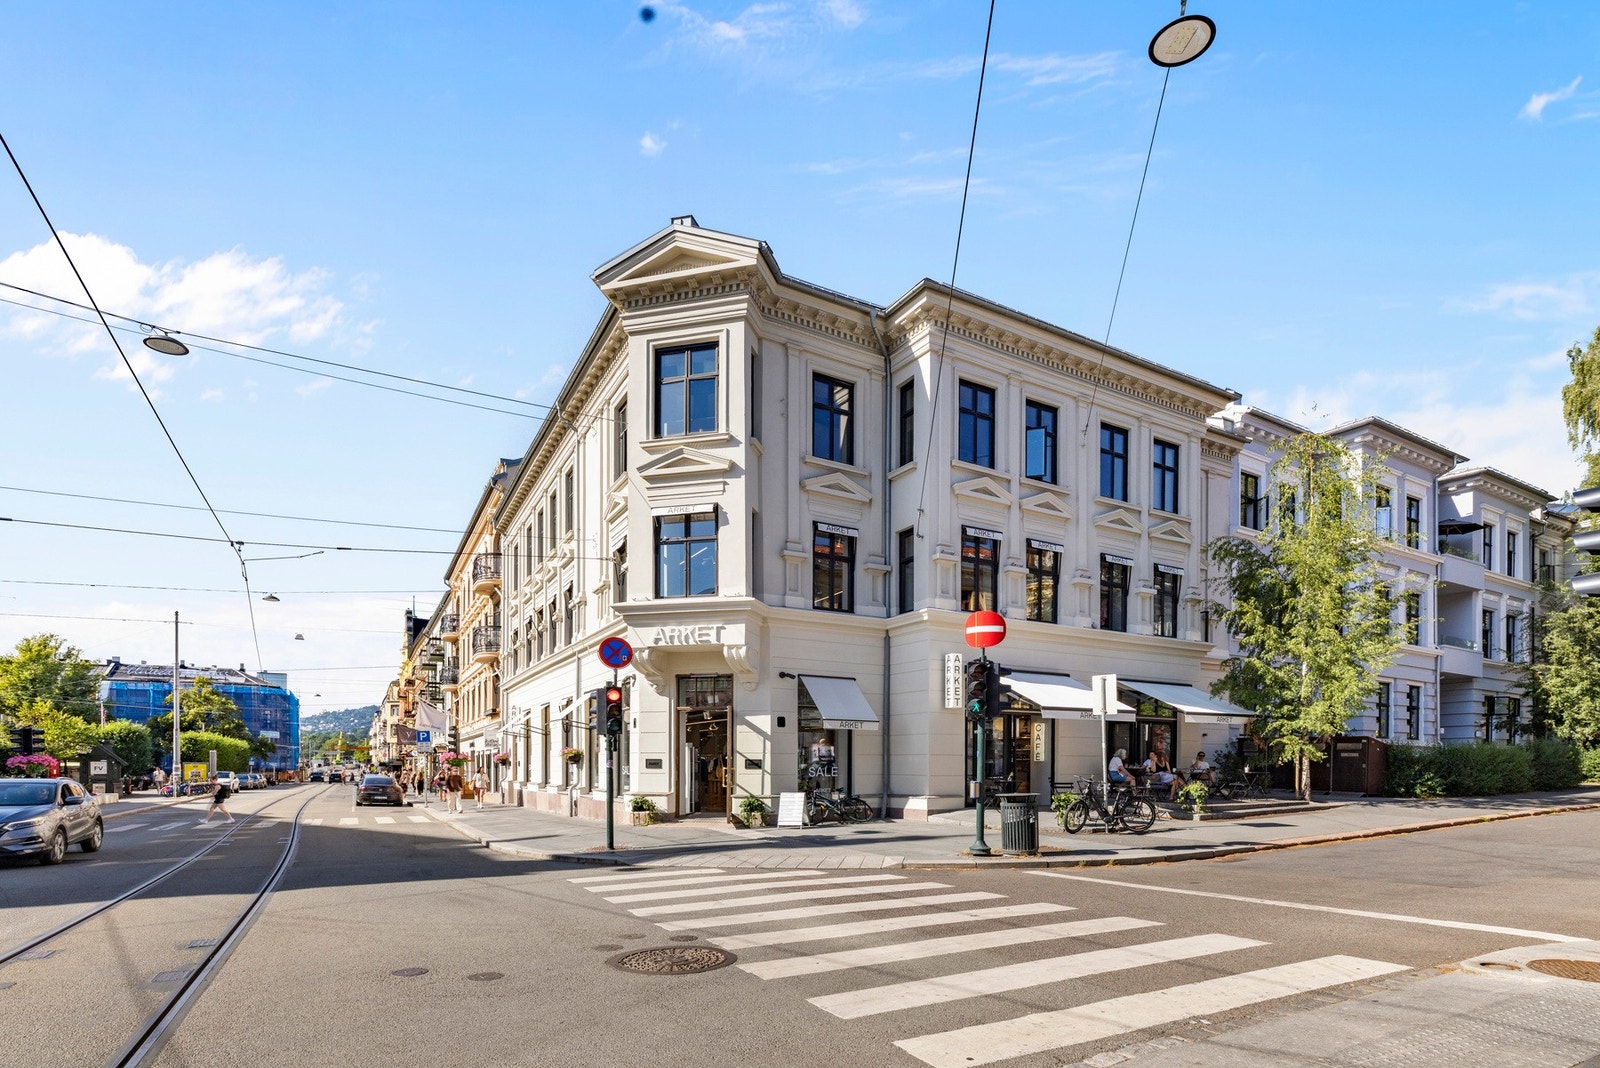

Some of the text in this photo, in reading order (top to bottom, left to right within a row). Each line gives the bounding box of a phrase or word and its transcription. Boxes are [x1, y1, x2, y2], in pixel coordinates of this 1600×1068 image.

[667, 505, 698, 514] ARKET
[826, 524, 849, 535] ARKET
[973, 528, 996, 539] ARKET
[1037, 540, 1058, 551] ARKET
[653, 624, 727, 645] ARKET
[839, 721, 864, 729] ARKET
[420, 732, 428, 741] P
[808, 766, 839, 778] SALE
